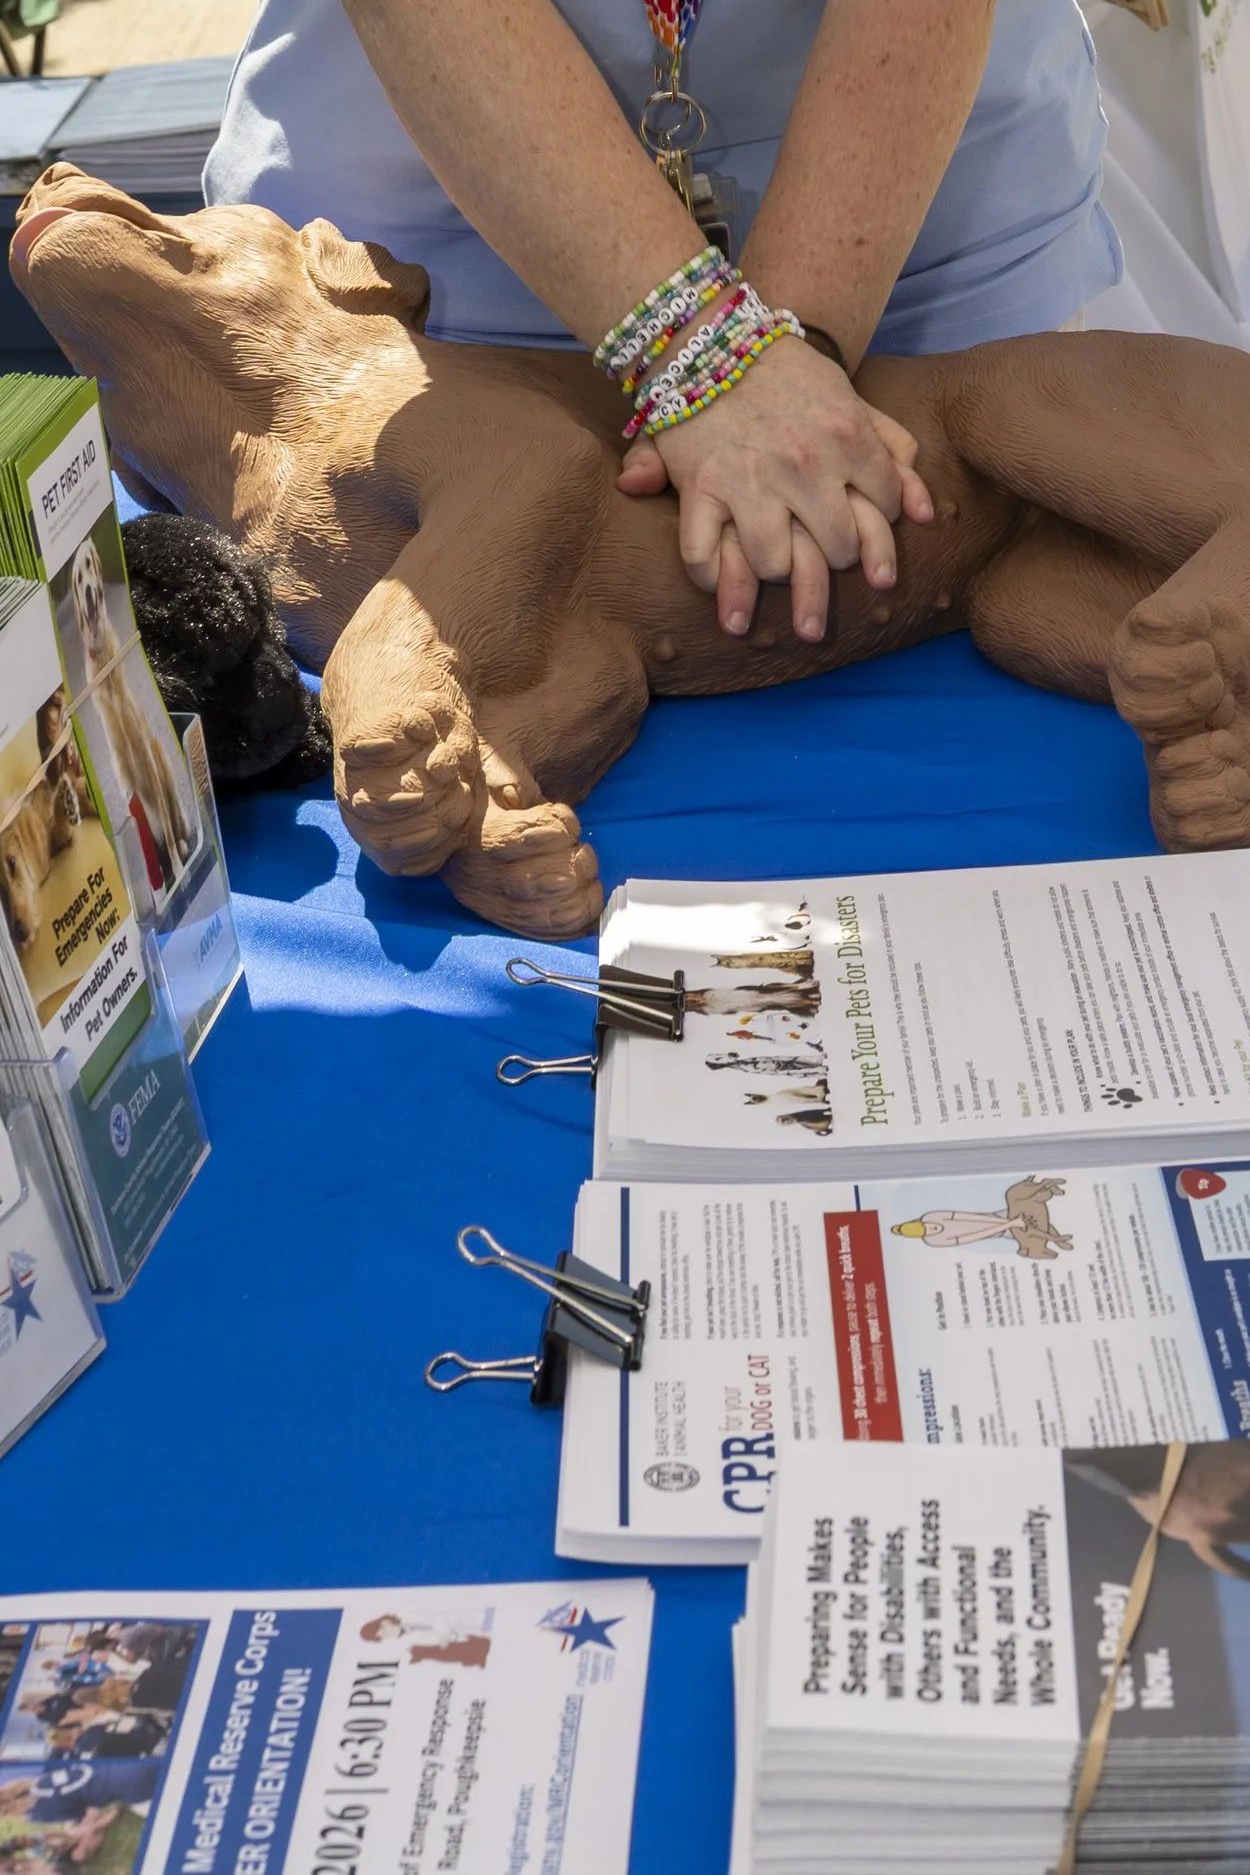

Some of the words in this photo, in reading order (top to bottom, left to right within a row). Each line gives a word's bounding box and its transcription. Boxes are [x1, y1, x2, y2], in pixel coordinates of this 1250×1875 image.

[661, 326, 712, 388] ALICE
[42, 482, 60, 519] PET
[60, 455, 82, 499] FIRST
[83, 439, 96, 471] AID
[52, 888, 89, 940] Prepare
[87, 867, 105, 894] For
[55, 887, 113, 967] Emergencies
[834, 895, 863, 958] Disasters
[60, 958, 113, 1034] Information
[112, 935, 128, 964] For
[85, 1009, 104, 1041] Pet
[102, 966, 138, 1018] Owners.
[837, 963, 867, 985] for
[845, 988, 871, 1018] Pets
[851, 1023, 877, 1060] Your
[128, 1069, 161, 1126] FEMA
[860, 1062, 894, 1126] Prepare
[672, 1379, 686, 1415] HEALTH
[748, 1354, 771, 1379] CAT
[753, 1381, 771, 1395] or
[654, 1379, 668, 1423] INSTITUTE
[718, 1414, 742, 1432] for
[723, 1386, 747, 1412] your
[750, 1400, 773, 1430] DOG
[853, 1407, 868, 1419] 30
[917, 1369, 944, 1444] mpressions:
[655, 1427, 668, 1457] BAKER
[673, 1417, 686, 1450] ANIMAL
[721, 1432, 776, 1513] CPR
[807, 1518, 833, 1582] Makes
[844, 1516, 874, 1584] People
[917, 1500, 940, 1568] Access
[988, 1548, 1012, 1578] the
[880, 1527, 909, 1643] Disabilities,
[917, 1577, 940, 1620] with
[1022, 1504, 1052, 1630] Community.
[843, 1592, 868, 1620] for
[951, 1545, 978, 1656] Functional
[988, 1586, 1014, 1624] and
[235, 1611, 280, 1676] Corps
[804, 1590, 838, 1695] Preparing
[841, 1629, 868, 1695] Sense
[917, 1629, 942, 1703] Others
[991, 1633, 1020, 1706] Needs,
[1028, 1639, 1055, 1706] Whole
[346, 1658, 400, 1709] PM
[880, 1653, 904, 1699] with
[954, 1664, 980, 1705] and
[1139, 1648, 1174, 1710] Now.
[208, 1679, 260, 1771] Reserve
[333, 1718, 388, 1778] 6:30
[421, 1678, 454, 1757] Response
[244, 1667, 312, 1839] ORIENTATION!
[446, 1698, 487, 1815] Poughkeepsie
[181, 1774, 236, 1873] Medical
[402, 1759, 443, 1857] Emergency
[436, 1819, 469, 1871] Road,
